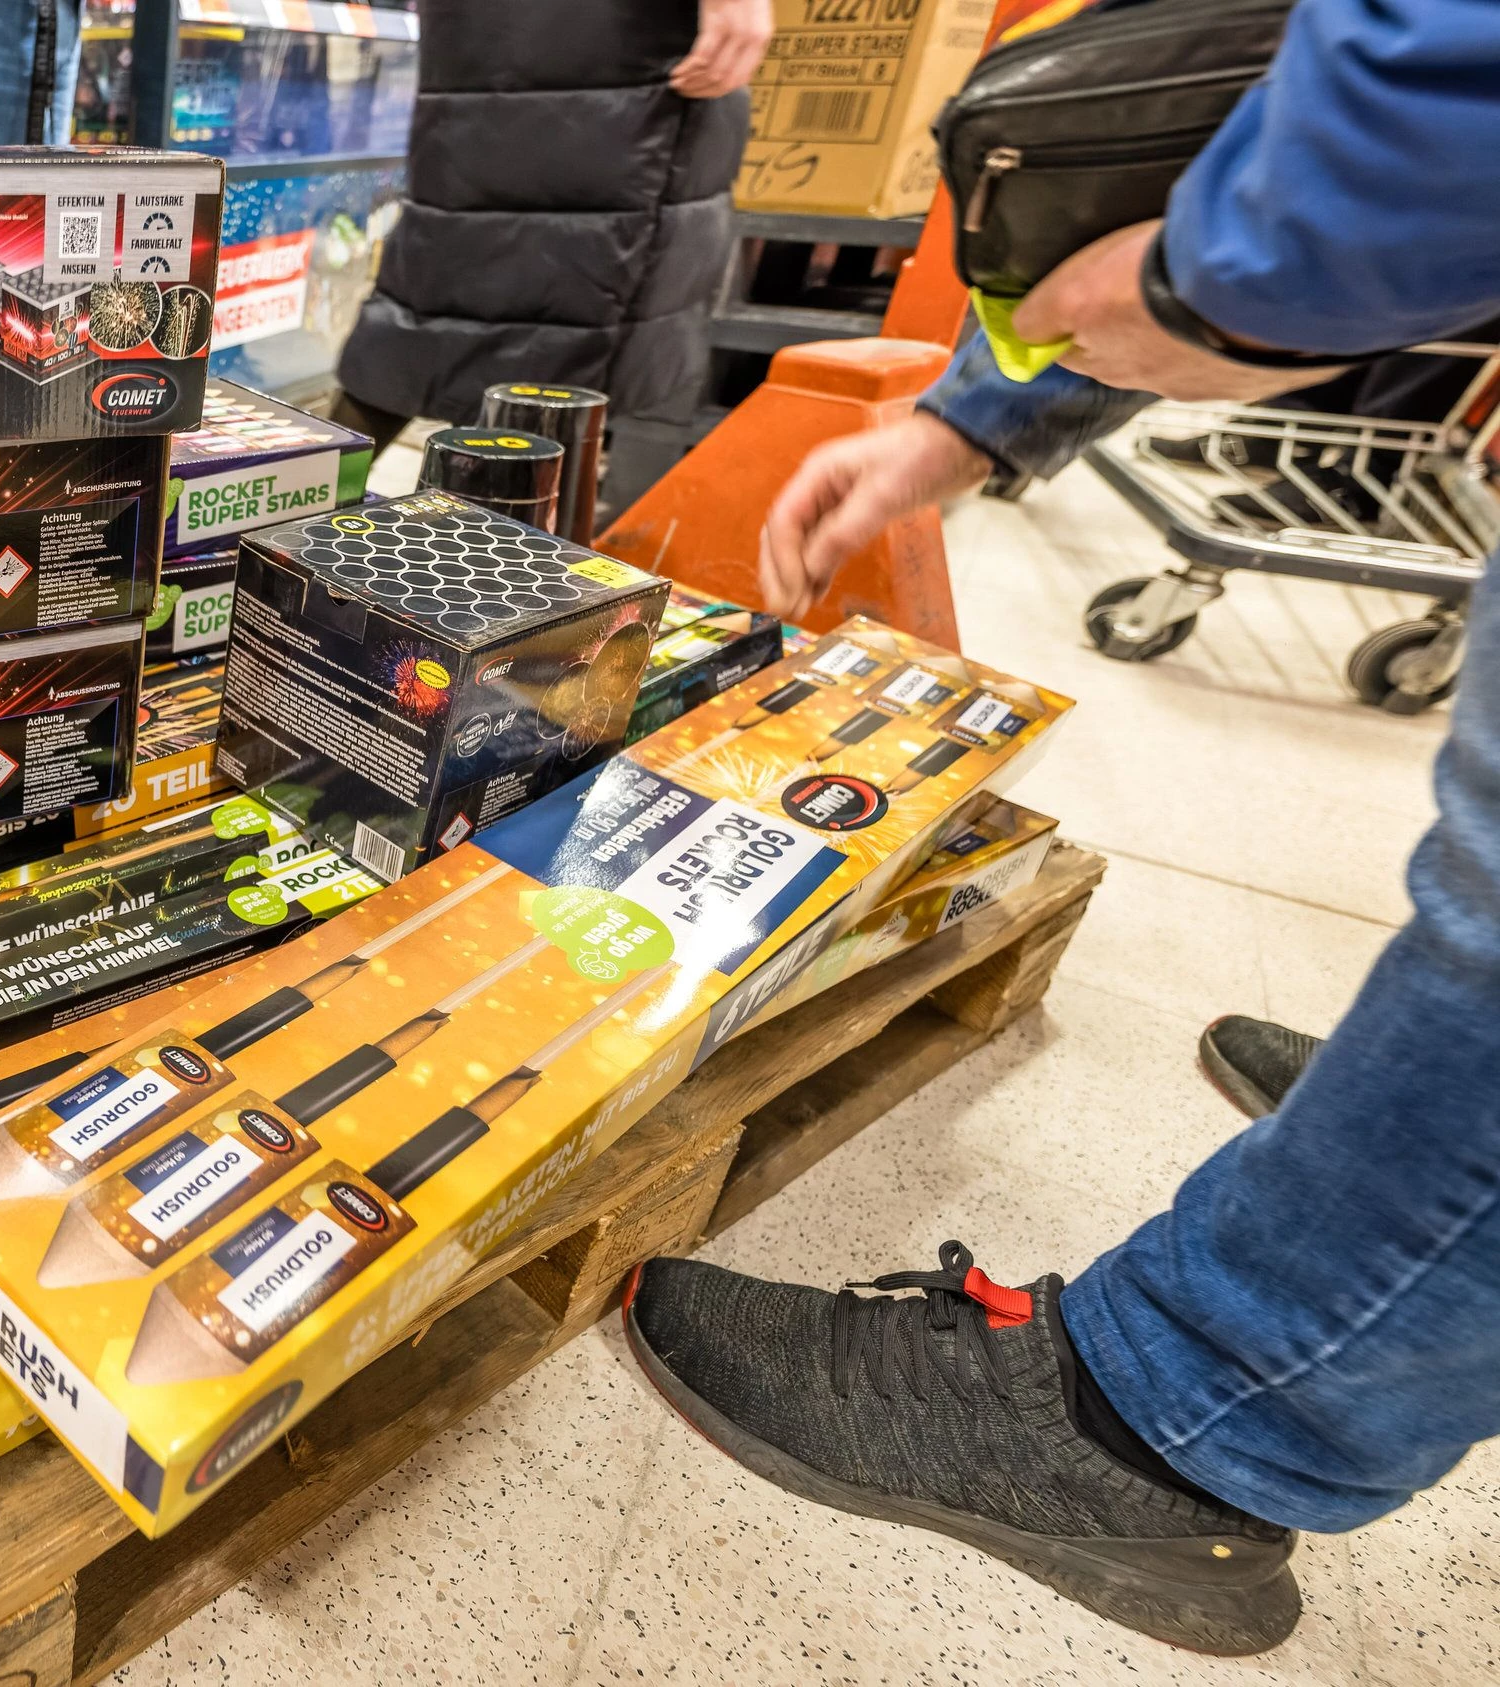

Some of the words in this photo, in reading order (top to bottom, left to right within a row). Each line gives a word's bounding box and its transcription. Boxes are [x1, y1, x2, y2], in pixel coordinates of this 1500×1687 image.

[58, 196, 105, 207] EFFEKTFILM
[135, 194, 184, 207] LAUTSTÄRKE
[131, 239, 183, 250] FARBVIELFALT
[61, 264, 96, 275] ANSEHEN
[216, 244, 309, 290] EUERWERK
[213, 295, 298, 336] NGEBOTEN
[107, 388, 167, 407] COMET
[111, 408, 152, 416] FEUERWERK
[73, 480, 141, 494] ABSCHUSSRICHTUNG
[188, 475, 278, 511] ROCKET
[41, 512, 81, 525] Achtung
[187, 502, 259, 530] SUPER
[267, 484, 330, 514] STARS
[483, 662, 513, 681] COMET
[56, 682, 120, 698] ABSCHUSSRICHTUNG
[27, 714, 64, 727] Achtung
[487, 772, 516, 789] Achtung
[800, 783, 856, 824] COMET
[673, 828, 796, 927] GOLDRH
[119, 892, 156, 917] AUF
[581, 908, 631, 946] green
[628, 924, 656, 948] we
[3, 934, 112, 981] WÜNSCHE
[114, 922, 156, 948] AUF
[605, 934, 631, 960] go
[23, 977, 46, 999] IN
[43, 959, 99, 994] DEN
[98, 933, 183, 971] HIMMEL
[714, 1003, 741, 1042] 6
[737, 923, 833, 1018] TEILE
[165, 1050, 202, 1075] COMET
[77, 1090, 98, 1104] Meter
[580, 1101, 620, 1141] MIT
[618, 1074, 652, 1113] BIS
[653, 1048, 681, 1083] ZU
[71, 1083, 159, 1145] GOLDRUSH
[246, 1114, 284, 1145] COMET
[151, 1151, 241, 1223] GOLDRUSH
[333, 1186, 377, 1222] COMET
[243, 1230, 333, 1311] GOLDRUSH
